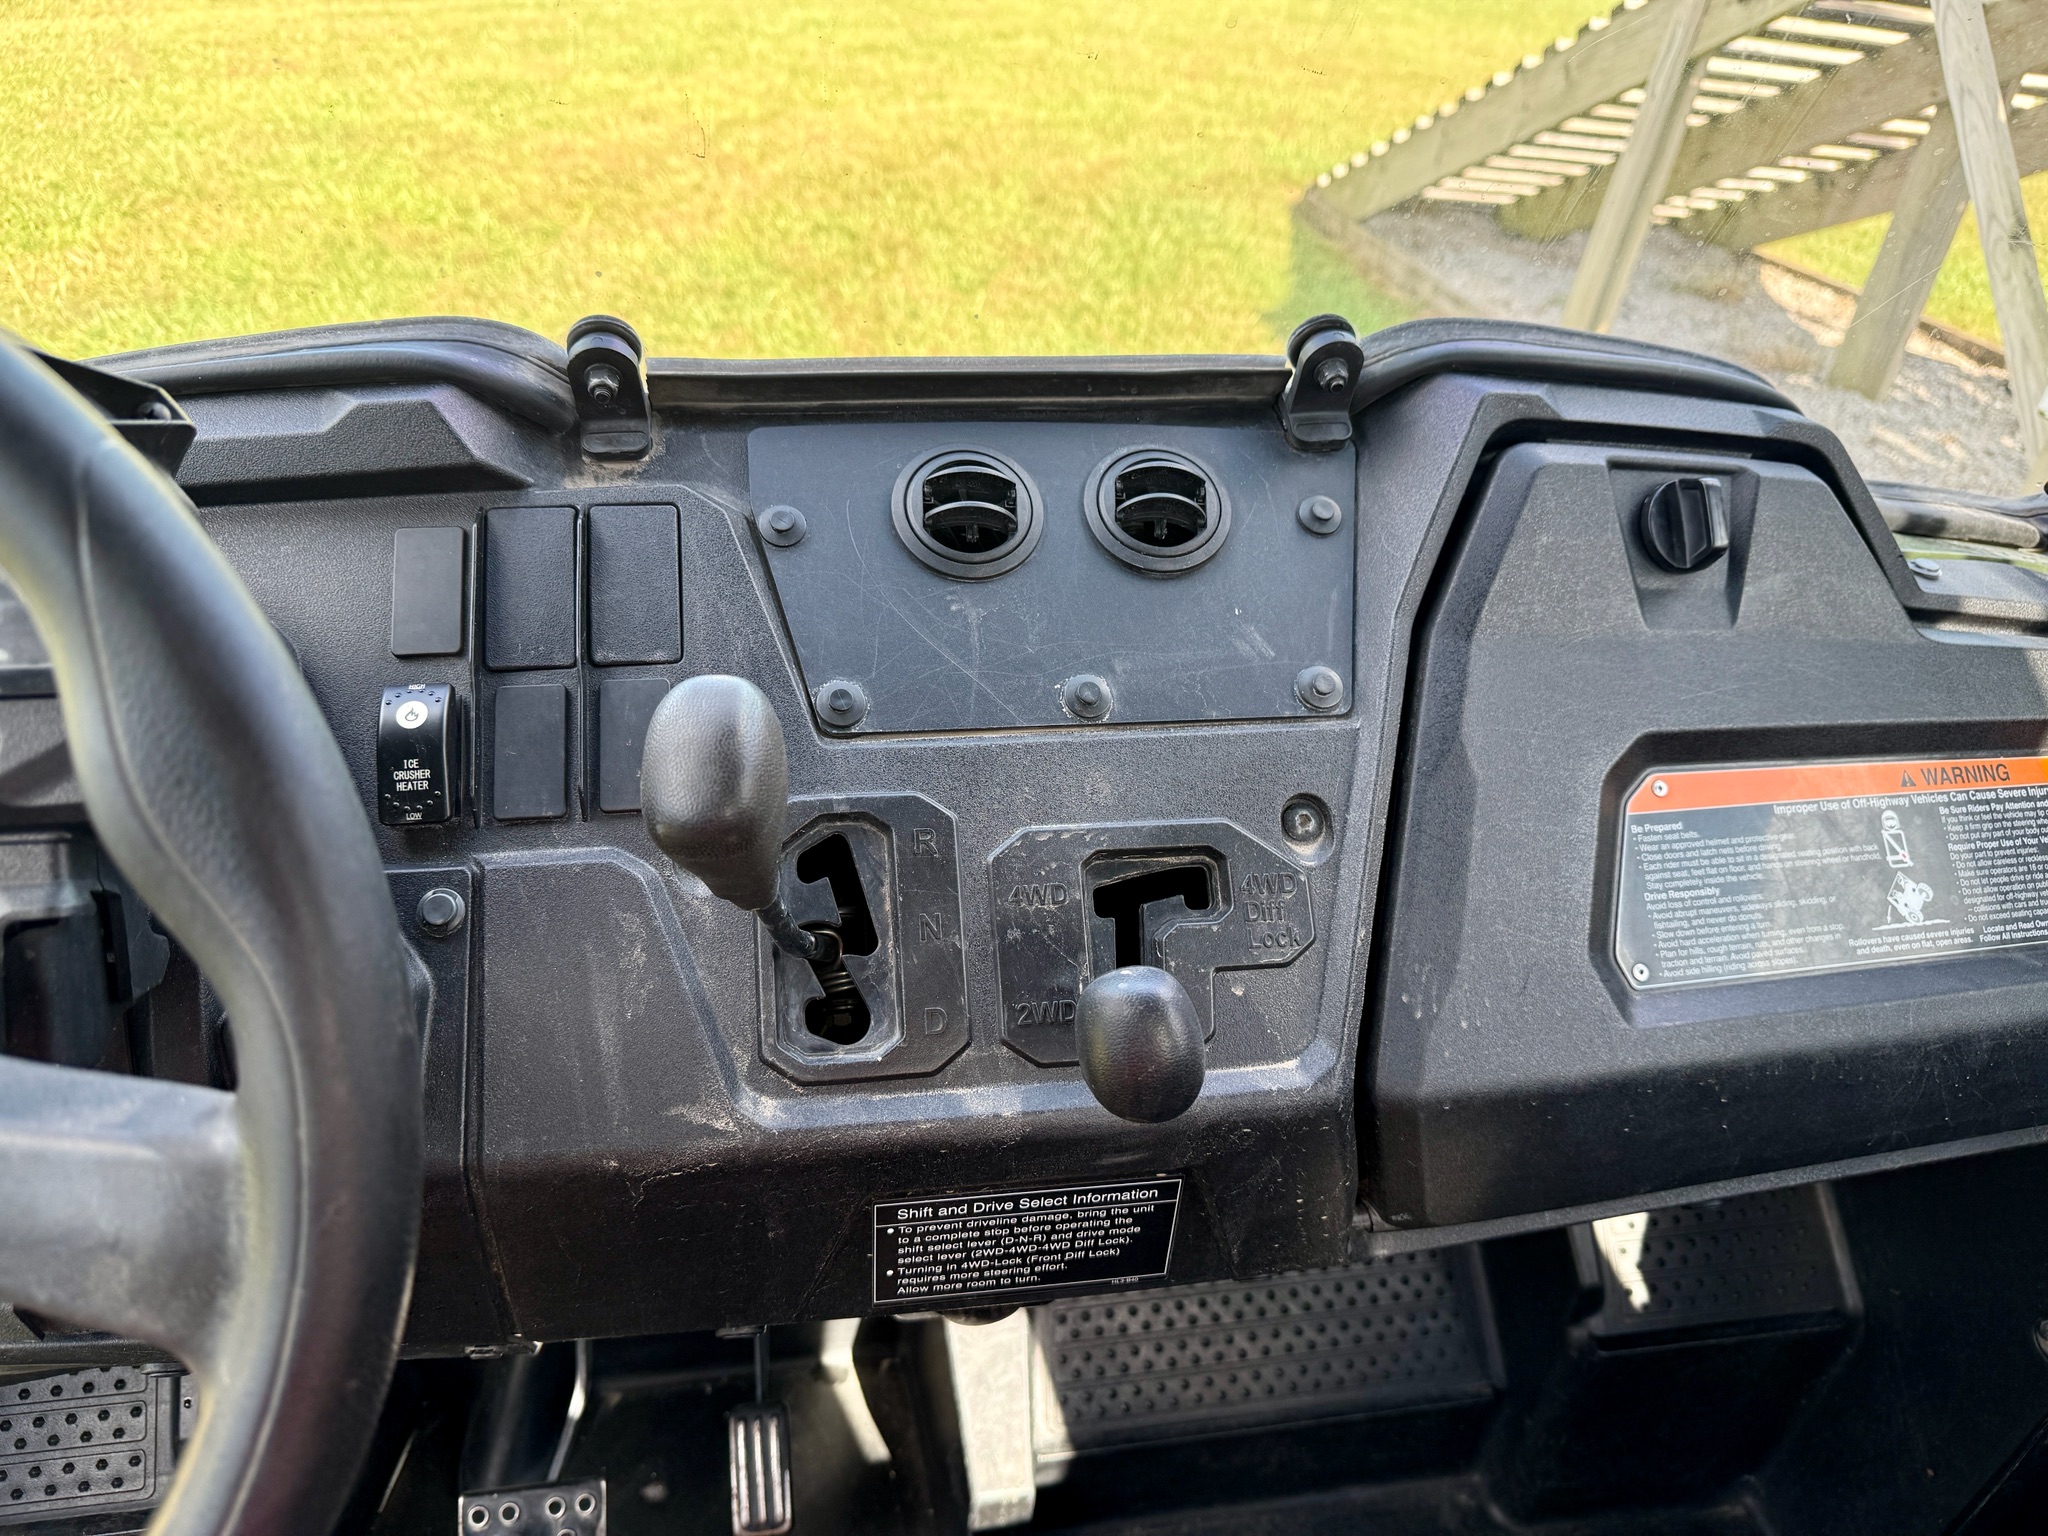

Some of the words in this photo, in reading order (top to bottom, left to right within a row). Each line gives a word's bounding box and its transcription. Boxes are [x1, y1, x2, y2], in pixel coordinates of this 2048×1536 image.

[394, 769, 430, 780] CRUSHER
[404, 759, 420, 769] ICE
[1920, 764, 2010, 786] WARNING
[396, 781, 428, 792] HEATER
[1773, 804, 1818, 816] Improper
[1820, 802, 1839, 811] Use
[1840, 800, 1851, 810] of
[1852, 798, 1909, 810] Off-Highway
[1910, 794, 1949, 805] Vehicles
[1950, 792, 1968, 802] Can
[1969, 791, 1996, 800] Cause
[1998, 789, 2027, 798] Severe
[1939, 806, 1949, 815] Be
[1950, 805, 1967, 814] Sure
[1967, 804, 1990, 813] Riders
[1990, 802, 2003, 812] Pay
[2005, 800, 2035, 810] Attention
[1631, 825, 1643, 833] Be
[913, 828, 938, 856] R
[1948, 841, 1975, 853] Require
[1976, 840, 1999, 850] Proper
[2000, 838, 2014, 847] Use
[2015, 837, 2022, 846] of
[2022, 837, 2038, 845] Your
[1007, 882, 1069, 908] 4WD
[1240, 872, 1299, 897] 4WD
[1644, 892, 1667, 901] Drive
[1245, 900, 1286, 922] Diff
[918, 912, 943, 942] N
[1248, 925, 1301, 950] Lock
[1849, 938, 1882, 947] Rollovers
[1883, 935, 1899, 943] have
[1901, 931, 1925, 942] caused
[1926, 931, 1949, 939] severe
[1950, 927, 1974, 938] injuries
[1980, 933, 2000, 942] Follow
[2002, 931, 2011, 940] All
[1983, 924, 2004, 933] Locate
[2005, 922, 2017, 931] and
[2018, 920, 2034, 929] Read
[1856, 946, 1870, 955] and
[1936, 939, 1952, 948] open
[924, 1007, 948, 1035] D
[1017, 999, 1077, 1027] 2WD
[897, 1206, 933, 1219] Shift
[938, 1203, 967, 1216] and
[973, 1201, 1013, 1213] Drive
[1019, 1195, 1068, 1209] Select
[1073, 1188, 1158, 1205] Information
[899, 1226, 912, 1234] To
[916, 1221, 962, 1234] prevent
[967, 1217, 1017, 1228] driveline
[1077, 1209, 1106, 1218] bring
[1111, 1207, 1128, 1216] the
[1133, 1204, 1154, 1214] unit
[925, 1230, 980, 1242] complete
[985, 1228, 1010, 1237] stop
[1014, 1224, 1052, 1234] before
[1056, 1218, 1110, 1231] operating
[1115, 1216, 1133, 1225] the
[898, 1244, 923, 1254] shift
[927, 1241, 963, 1251] select
[968, 1239, 996, 1248] lever
[1000, 1233, 1046, 1246] (D-N-R)
[1051, 1231, 1072, 1240] and
[1076, 1229, 1104, 1238] drive
[1109, 1225, 1141, 1235] mode
[898, 1253, 933, 1264] select
[937, 1252, 967, 1260] lever
[971, 1241, 1070, 1258] (2WD-4WD-4WD
[1075, 1238, 1094, 1248] Diff
[1098, 1235, 1133, 1246] Lock).
[897, 1264, 942, 1275] Turning
[947, 1262, 957, 1271] in
[961, 1256, 1022, 1269] 4WD-Lock
[1027, 1253, 1061, 1264] (Front
[1065, 1250, 1085, 1260] Diff
[1089, 1247, 1120, 1258] Lock)
[897, 1274, 946, 1285] requires
[950, 1271, 979, 1279] more
[984, 1265, 1030, 1276] steering
[1035, 1262, 1068, 1272] effort.
[897, 1285, 929, 1294] Allow
[933, 1282, 963, 1291] more
[967, 1279, 996, 1288] room
[1015, 1275, 1040, 1283] turn.
